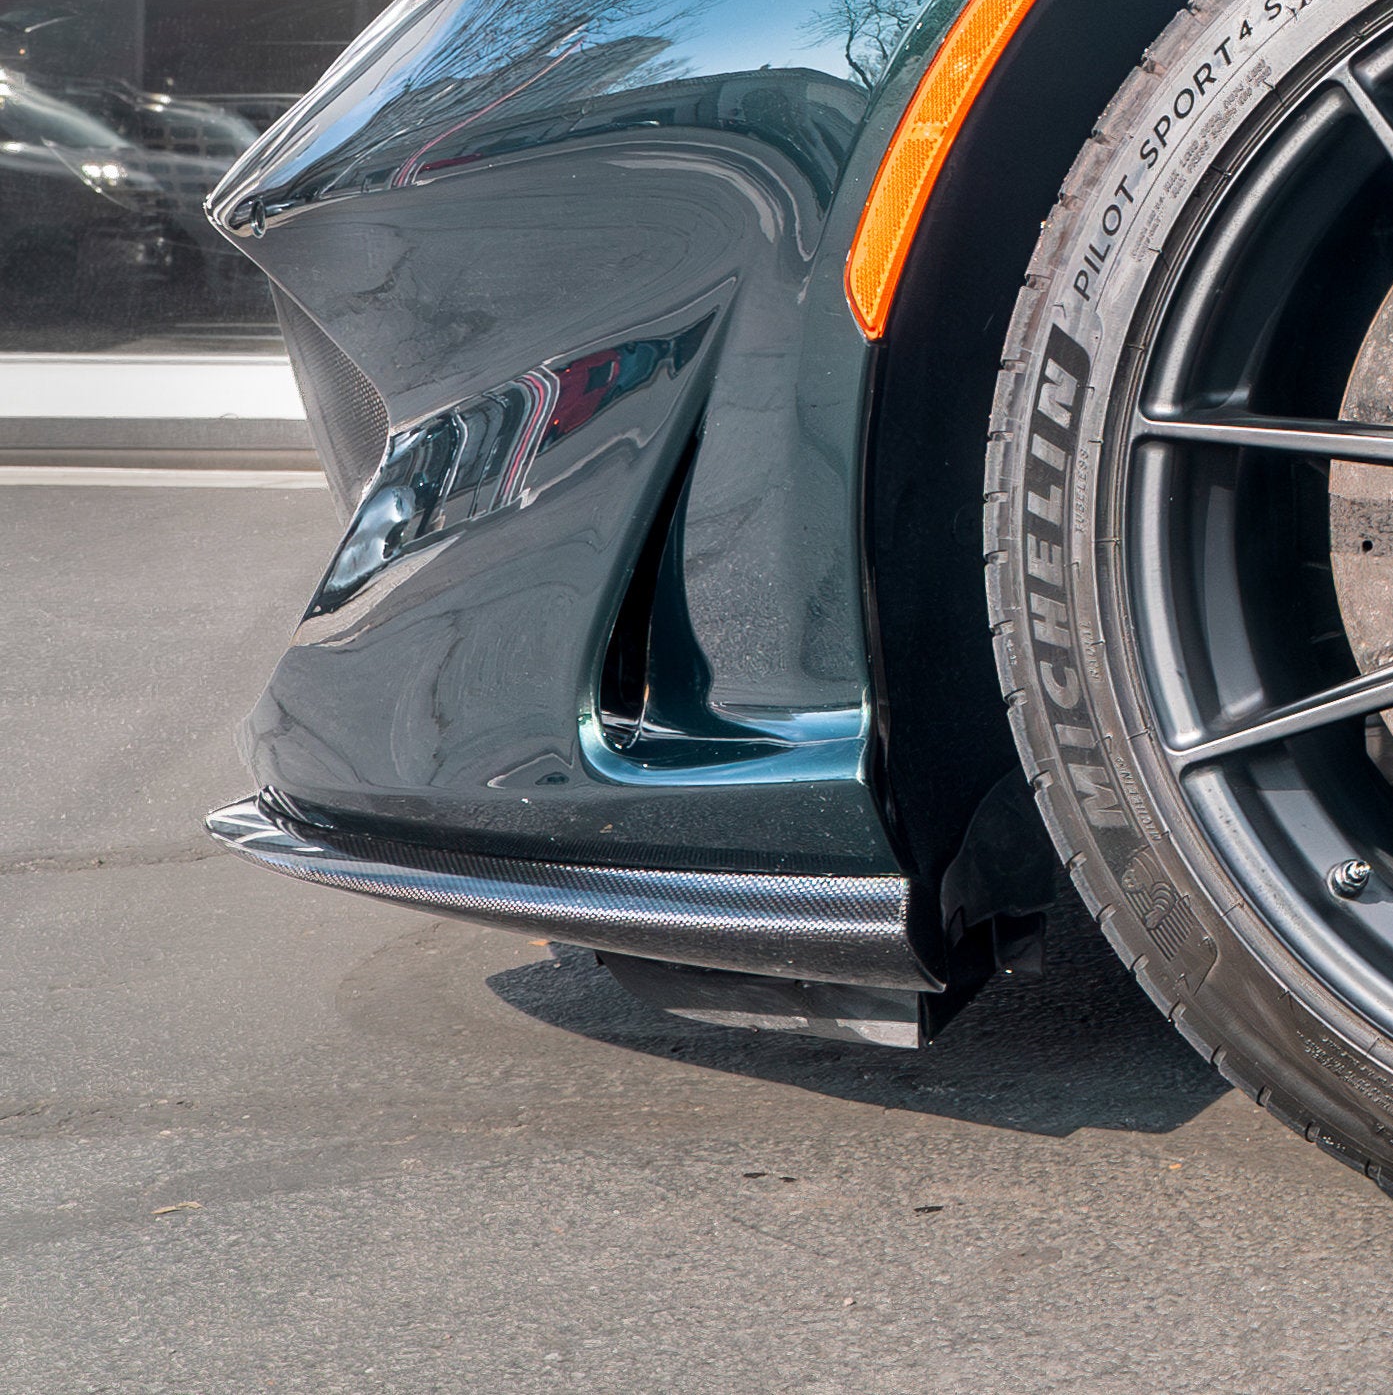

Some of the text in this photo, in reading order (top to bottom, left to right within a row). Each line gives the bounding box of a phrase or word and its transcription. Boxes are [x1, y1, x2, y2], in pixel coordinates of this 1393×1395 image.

[1071, 173, 1134, 303] PILOT
[1137, 34, 1231, 171] SPORT
[1236, 18, 1254, 43] 4
[1027, 356, 1131, 825] MICHELIN
[1074, 446, 1090, 533] TUBELESS
